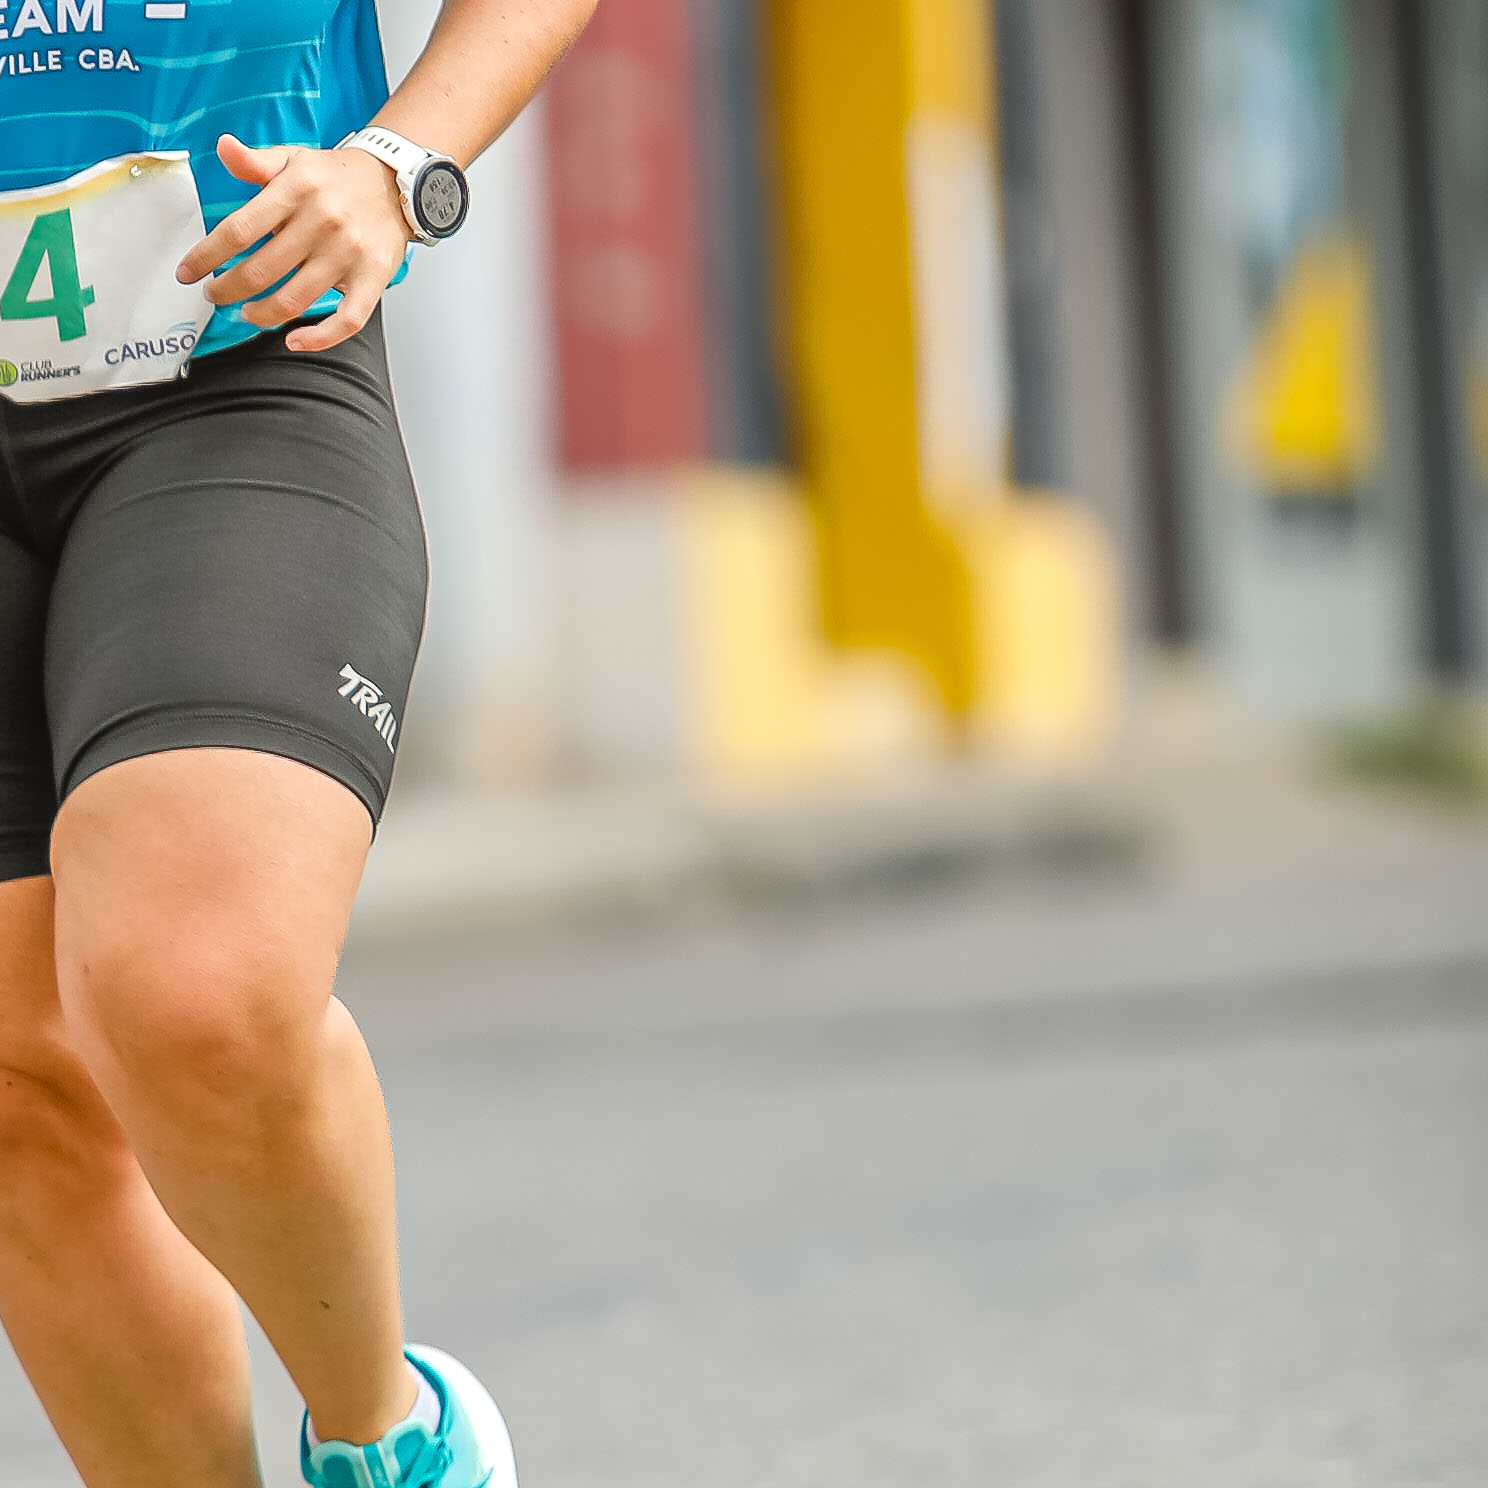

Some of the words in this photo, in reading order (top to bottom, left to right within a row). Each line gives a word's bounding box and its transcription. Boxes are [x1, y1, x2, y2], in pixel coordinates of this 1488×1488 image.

[78, 48, 140, 72] CBA.
[0, 207, 95, 342] 4
[104, 333, 196, 365] CARUSO
[337, 663, 398, 755] TRAIL
